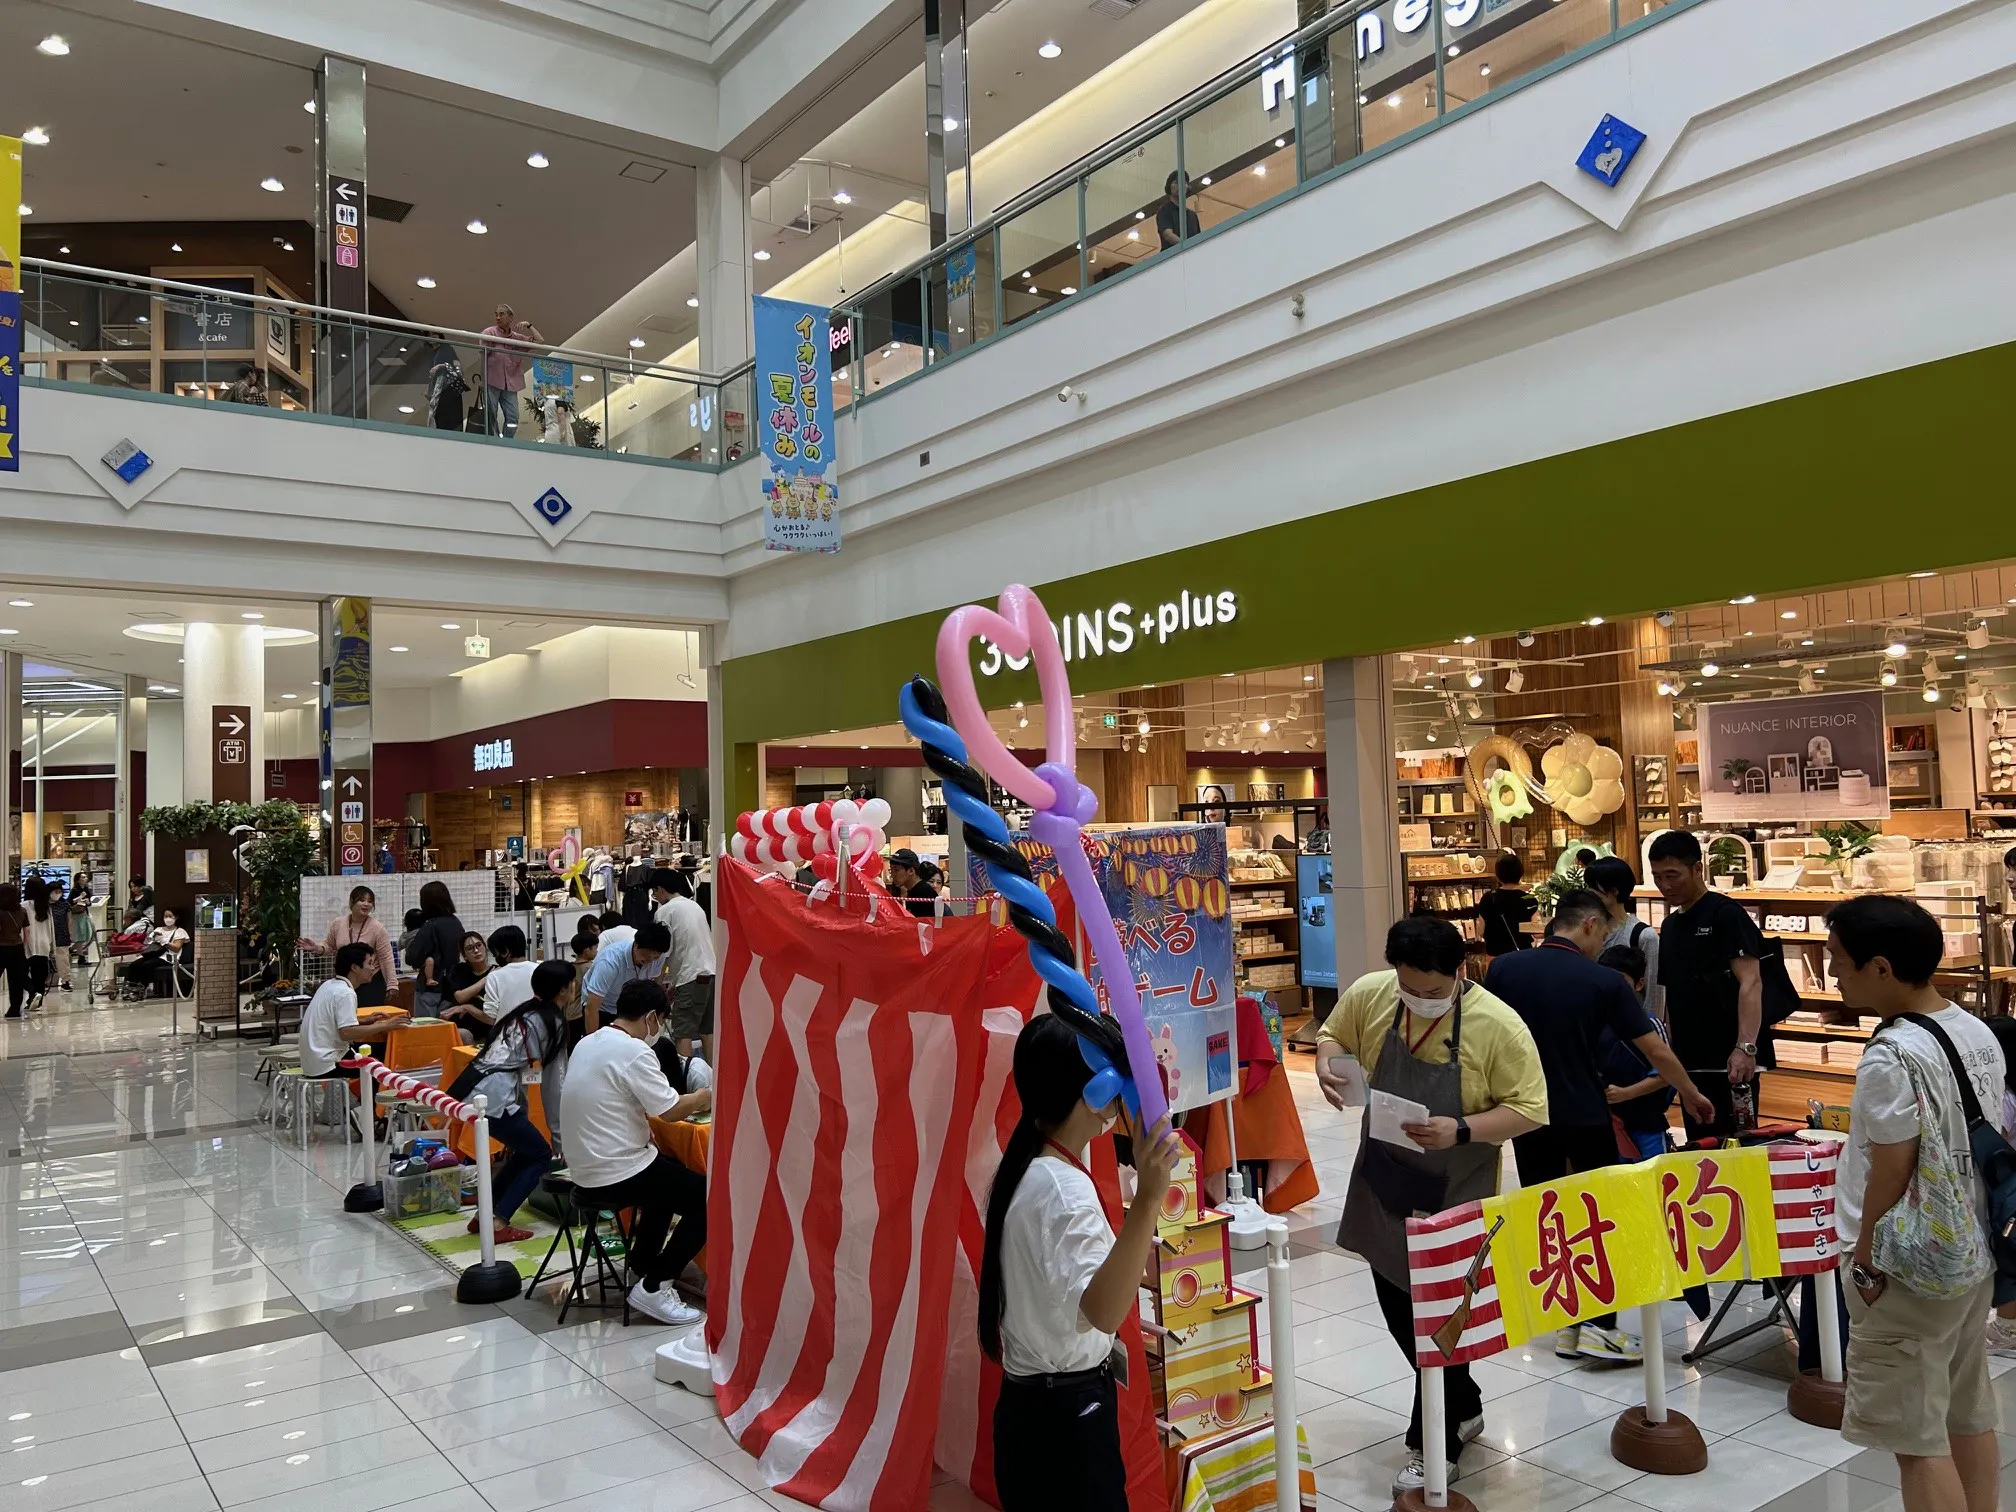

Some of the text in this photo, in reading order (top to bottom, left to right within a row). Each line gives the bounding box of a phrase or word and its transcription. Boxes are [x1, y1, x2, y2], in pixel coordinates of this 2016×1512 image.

[828, 318, 851, 352] feel
[769, 372, 799, 460] 夏休み
[795, 313, 824, 462] イオンモールの
[1720, 712, 1857, 736] NUANCE INTERIOR
[1208, 1037, 1228, 1051] GAME
[1529, 1156, 1743, 1319] 射的
[1803, 1150, 1829, 1257] しゃてき
